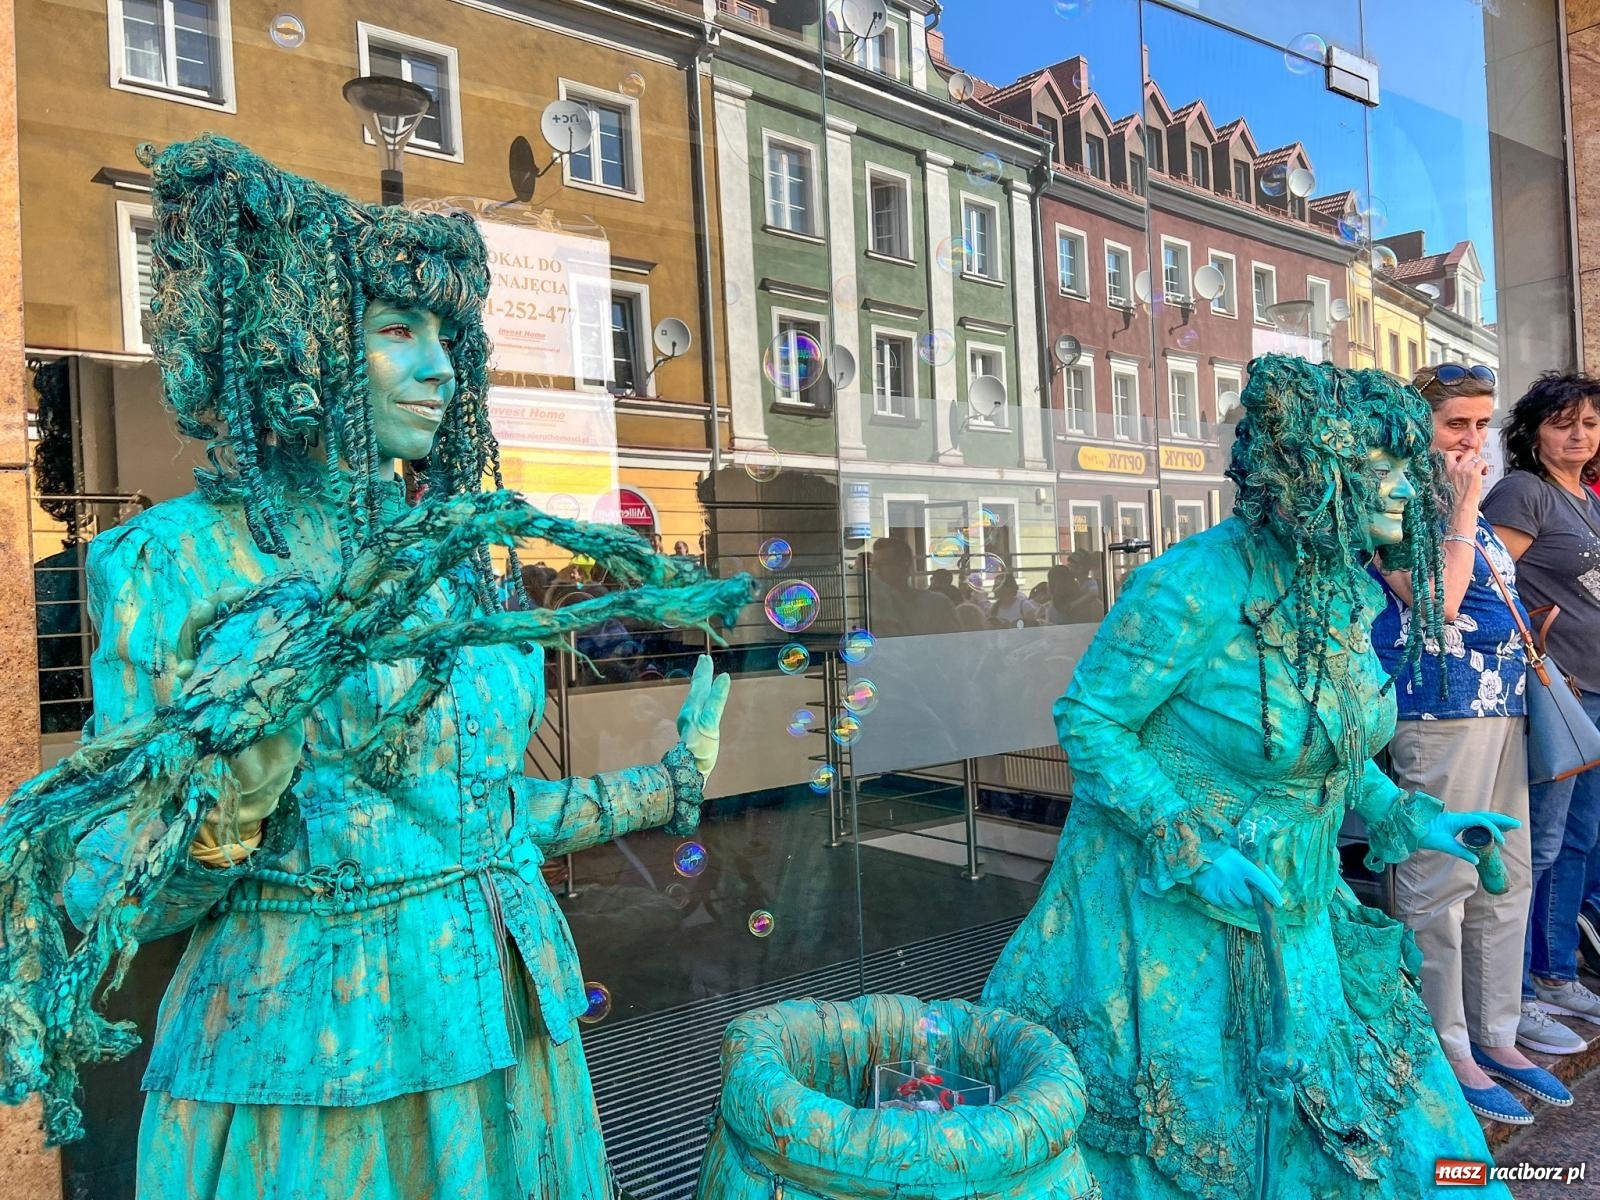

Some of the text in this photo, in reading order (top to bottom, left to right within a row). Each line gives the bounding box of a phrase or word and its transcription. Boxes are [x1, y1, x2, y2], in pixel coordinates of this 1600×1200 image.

[488, 250, 562, 273] OKAL DO
[491, 273, 568, 295] NAJĘCIA
[487, 298, 576, 324] 1-252-477
[490, 407, 566, 420] nvest Home
